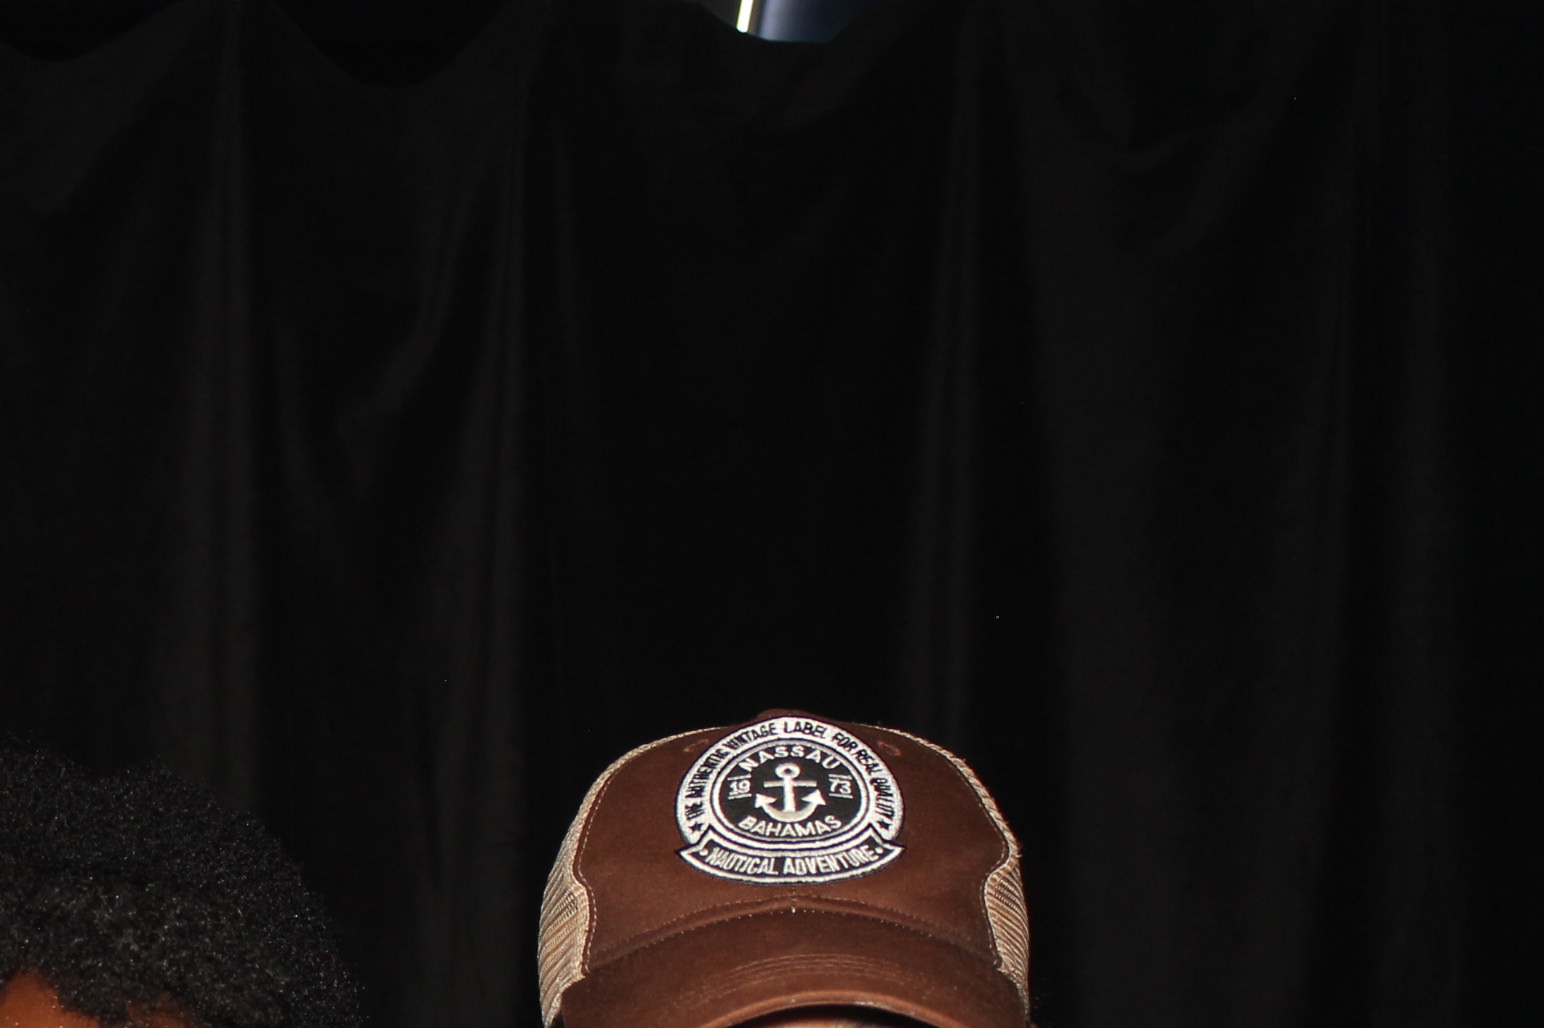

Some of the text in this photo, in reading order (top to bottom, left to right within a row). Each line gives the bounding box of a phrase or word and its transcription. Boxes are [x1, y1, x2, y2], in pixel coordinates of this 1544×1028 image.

[721, 722, 777, 751] VINTAGE
[784, 720, 827, 739] LABEL
[832, 731, 858, 753] FOR
[855, 748, 882, 775] REAL
[738, 746, 841, 773] NASSAU
[728, 778, 852, 796] 19 73
[737, 815, 842, 837] BAHAMAS
[707, 844, 877, 875] NAUTICAL ADVENTURE
